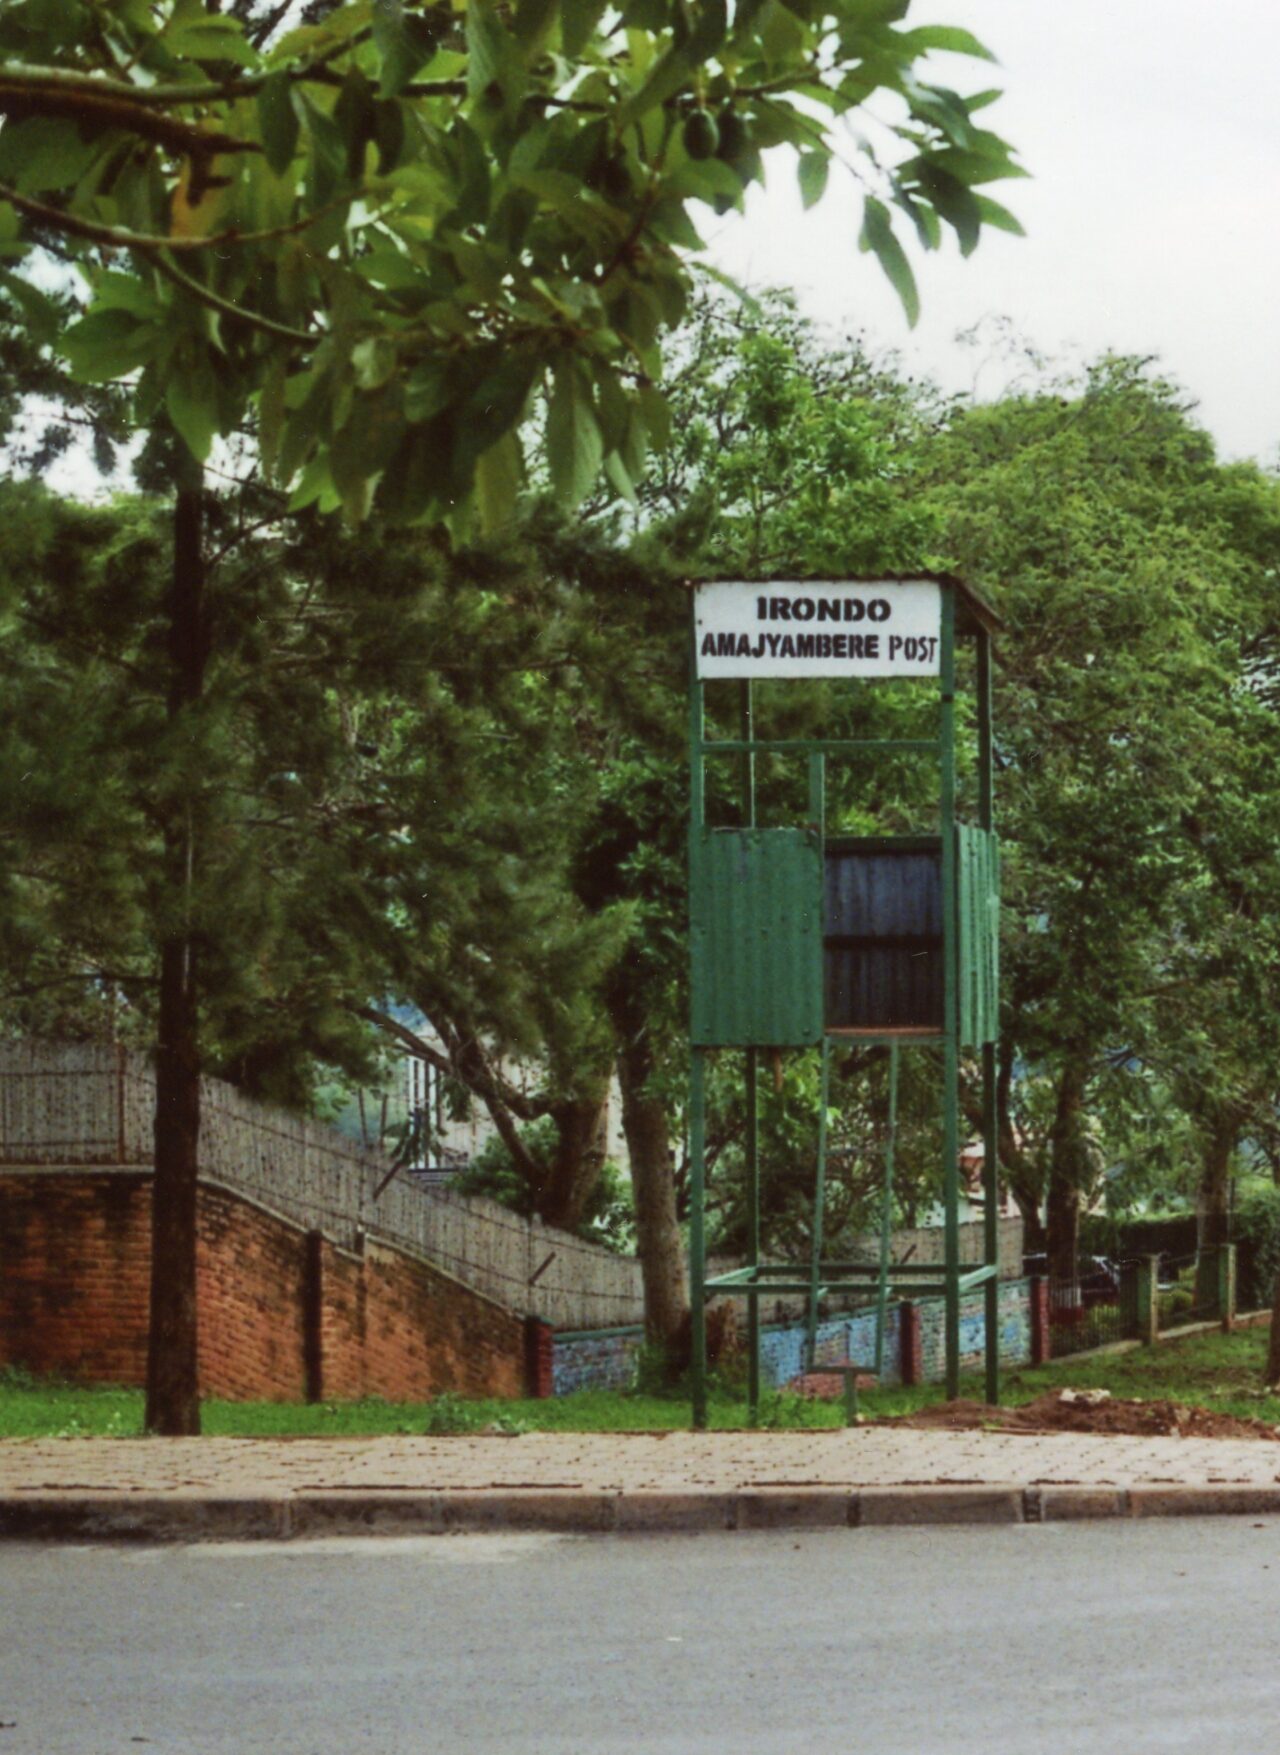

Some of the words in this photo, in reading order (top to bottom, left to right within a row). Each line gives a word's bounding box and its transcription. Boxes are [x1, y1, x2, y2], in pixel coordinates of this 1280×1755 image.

[756, 596, 892, 622] IRONDO
[701, 632, 880, 659] AMAJYAMBERE
[888, 634, 939, 663] POST
